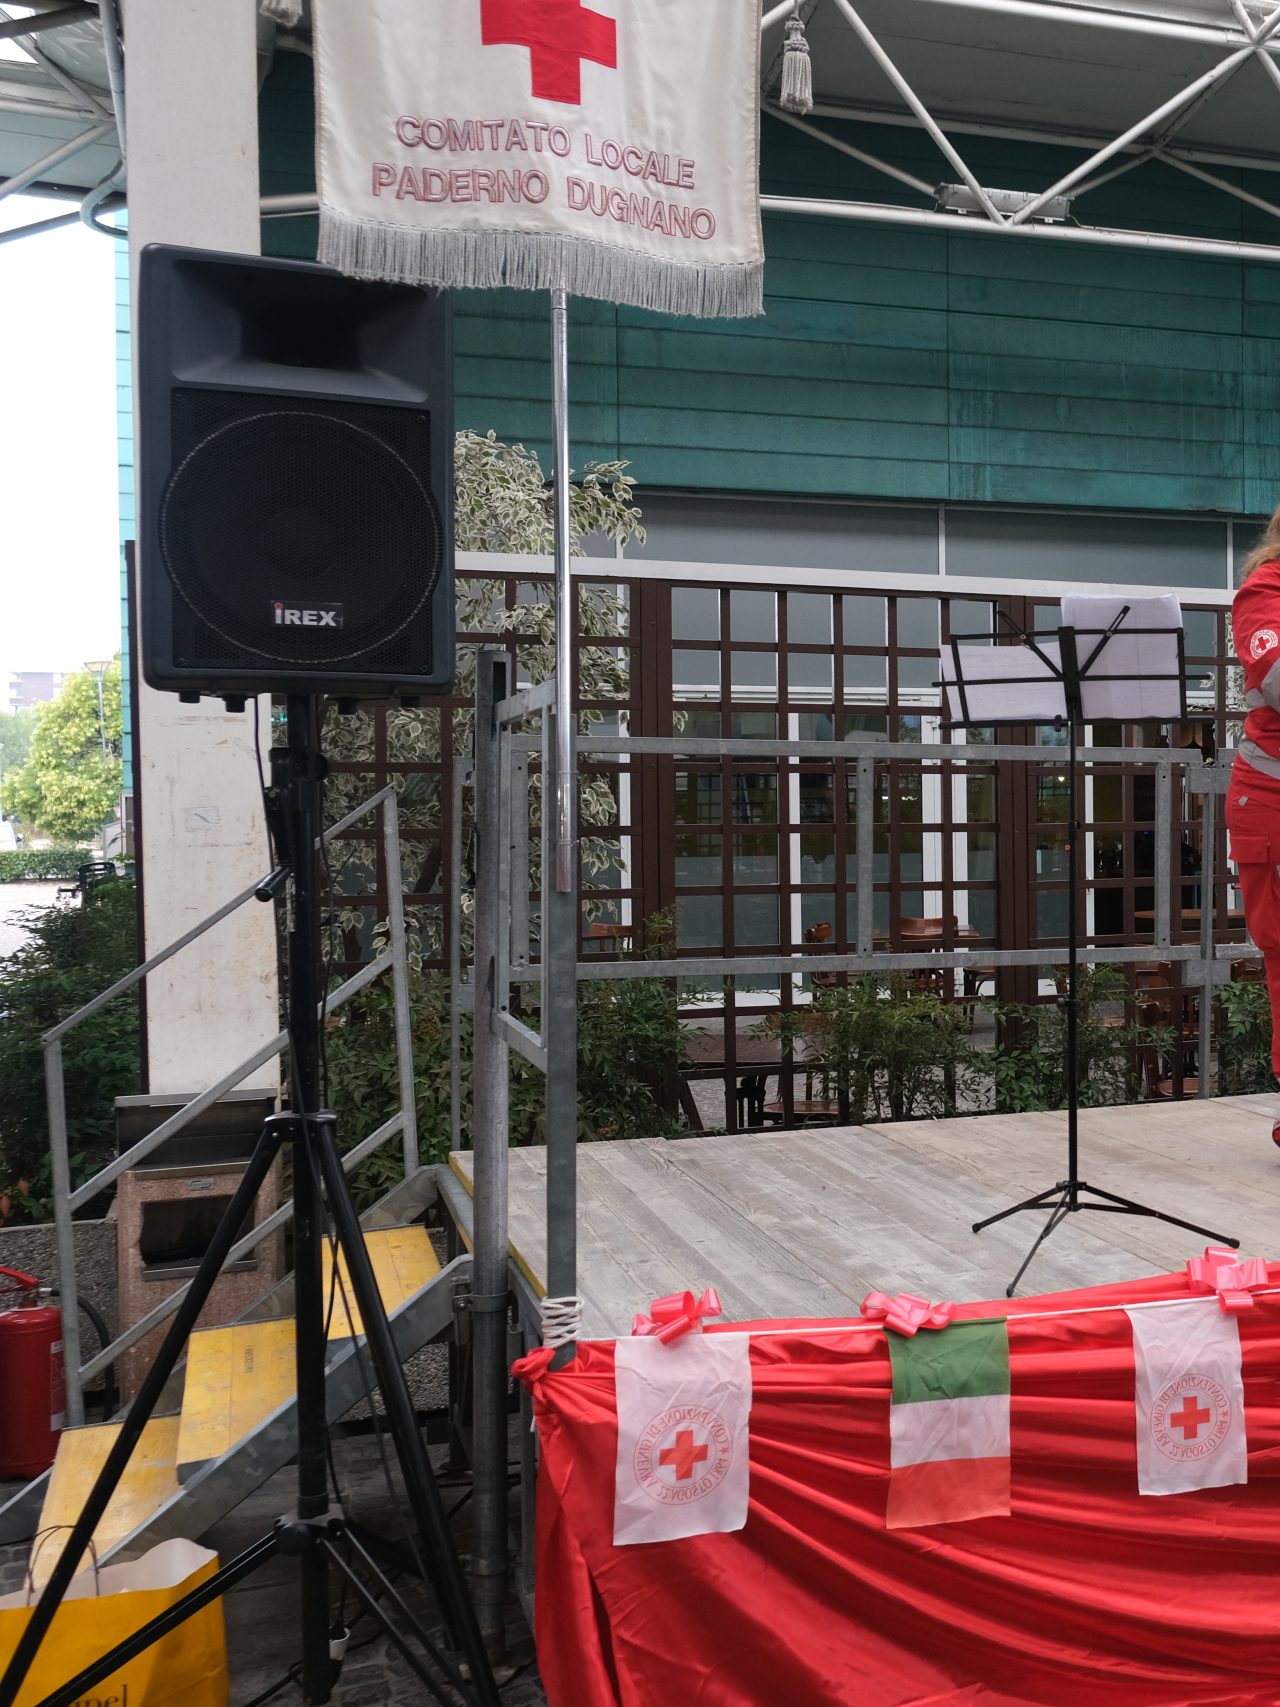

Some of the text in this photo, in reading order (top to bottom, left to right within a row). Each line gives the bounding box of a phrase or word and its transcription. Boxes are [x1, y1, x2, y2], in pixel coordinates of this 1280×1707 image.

[396, 116, 695, 190] COMITATO LOCALE
[372, 163, 716, 240] PADERNO DUGNANO
